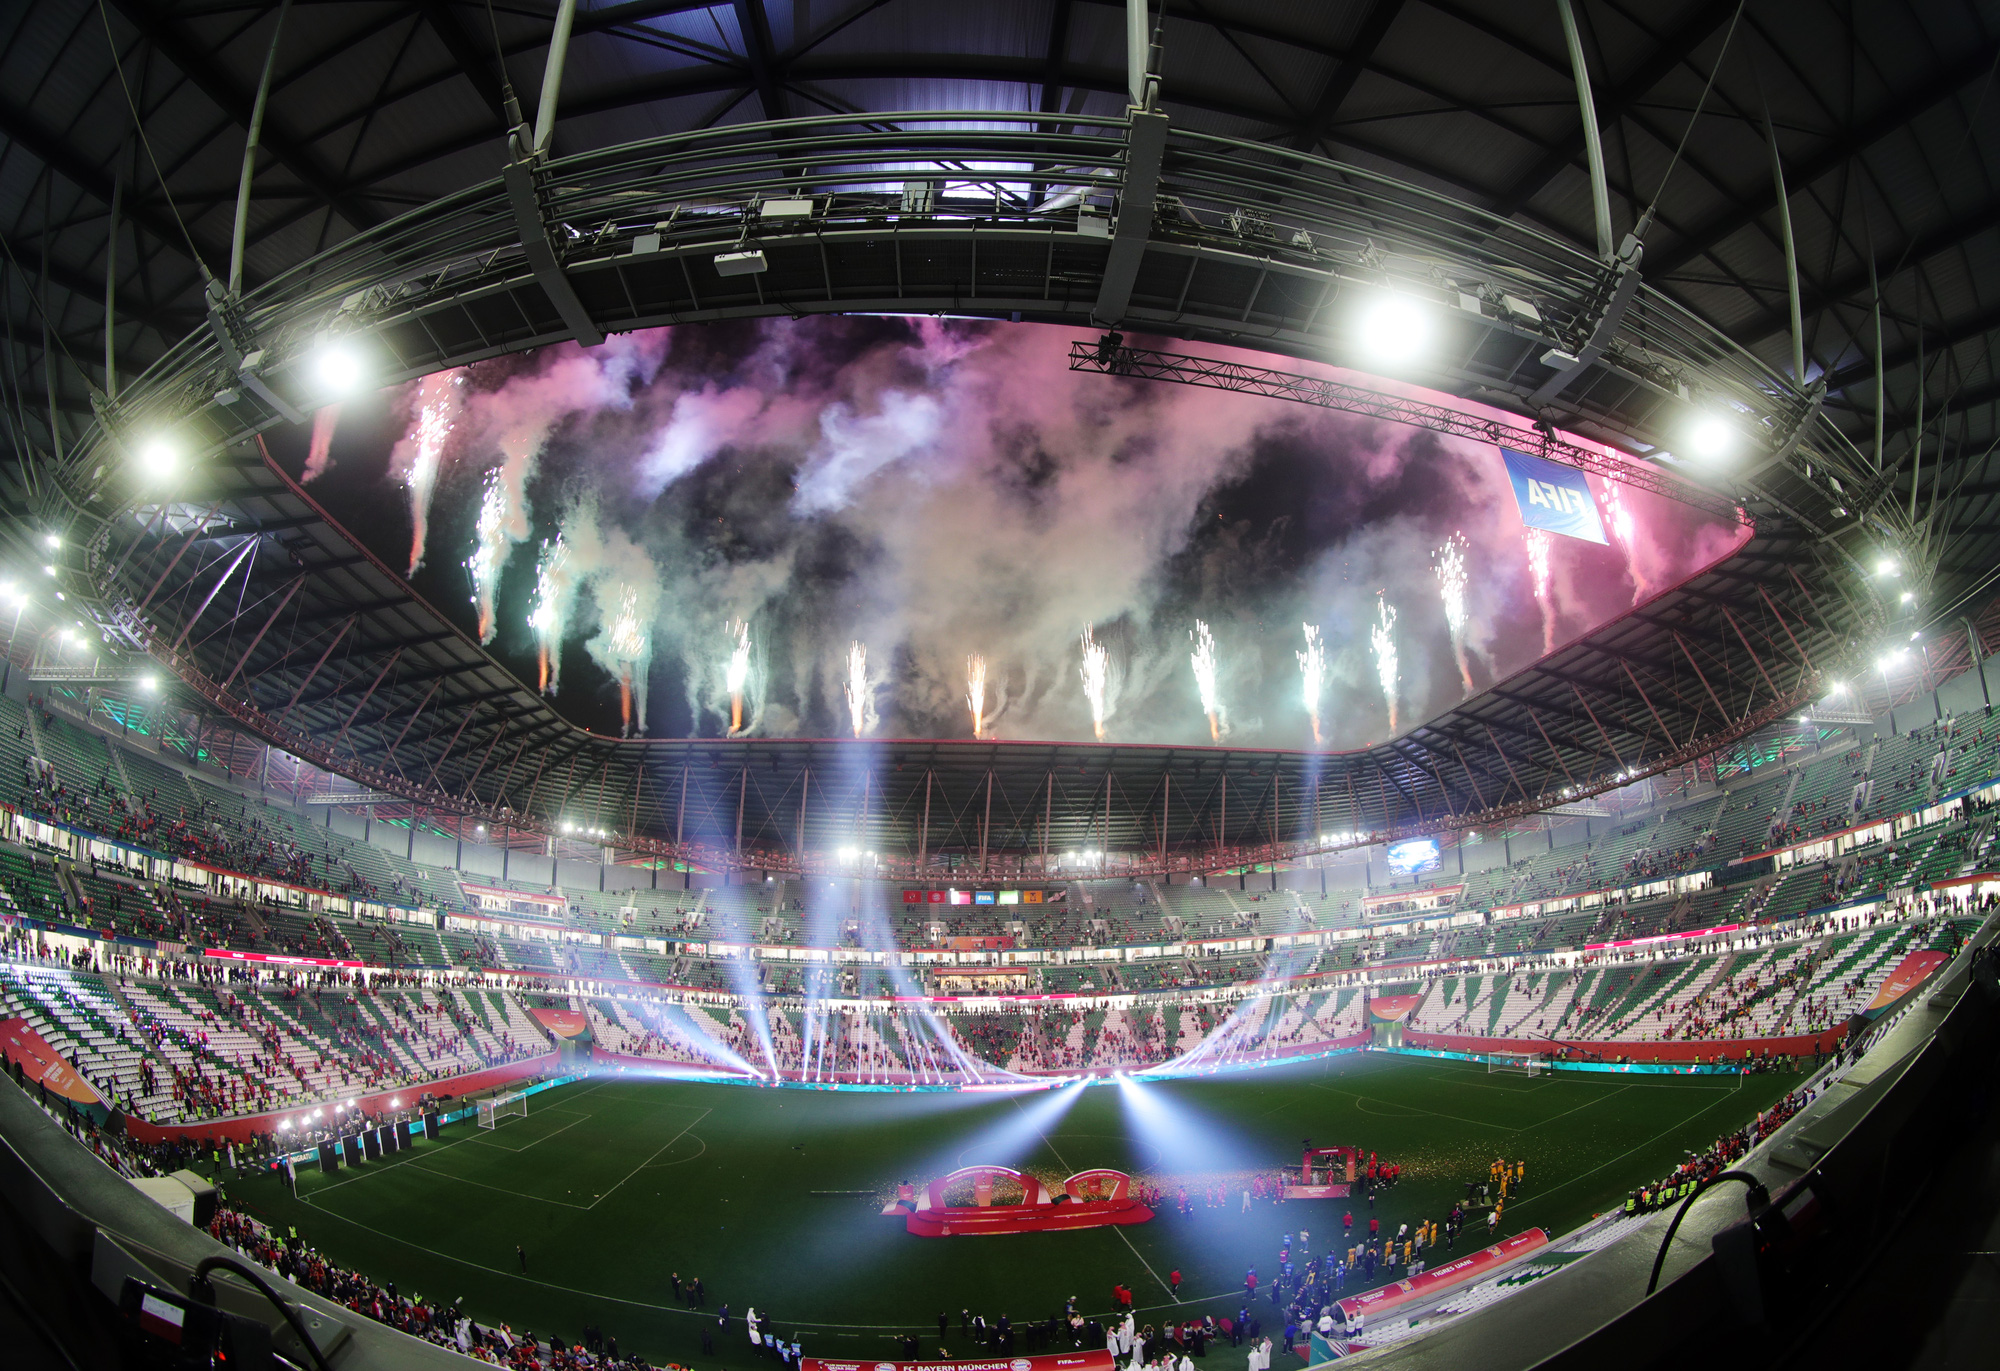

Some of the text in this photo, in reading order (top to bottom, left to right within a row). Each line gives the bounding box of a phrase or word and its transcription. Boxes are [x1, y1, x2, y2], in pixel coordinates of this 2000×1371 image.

[1432, 1259, 1474, 1278] TIGRES UANL
[958, 1363, 1008, 1371] MÜNCHEN
